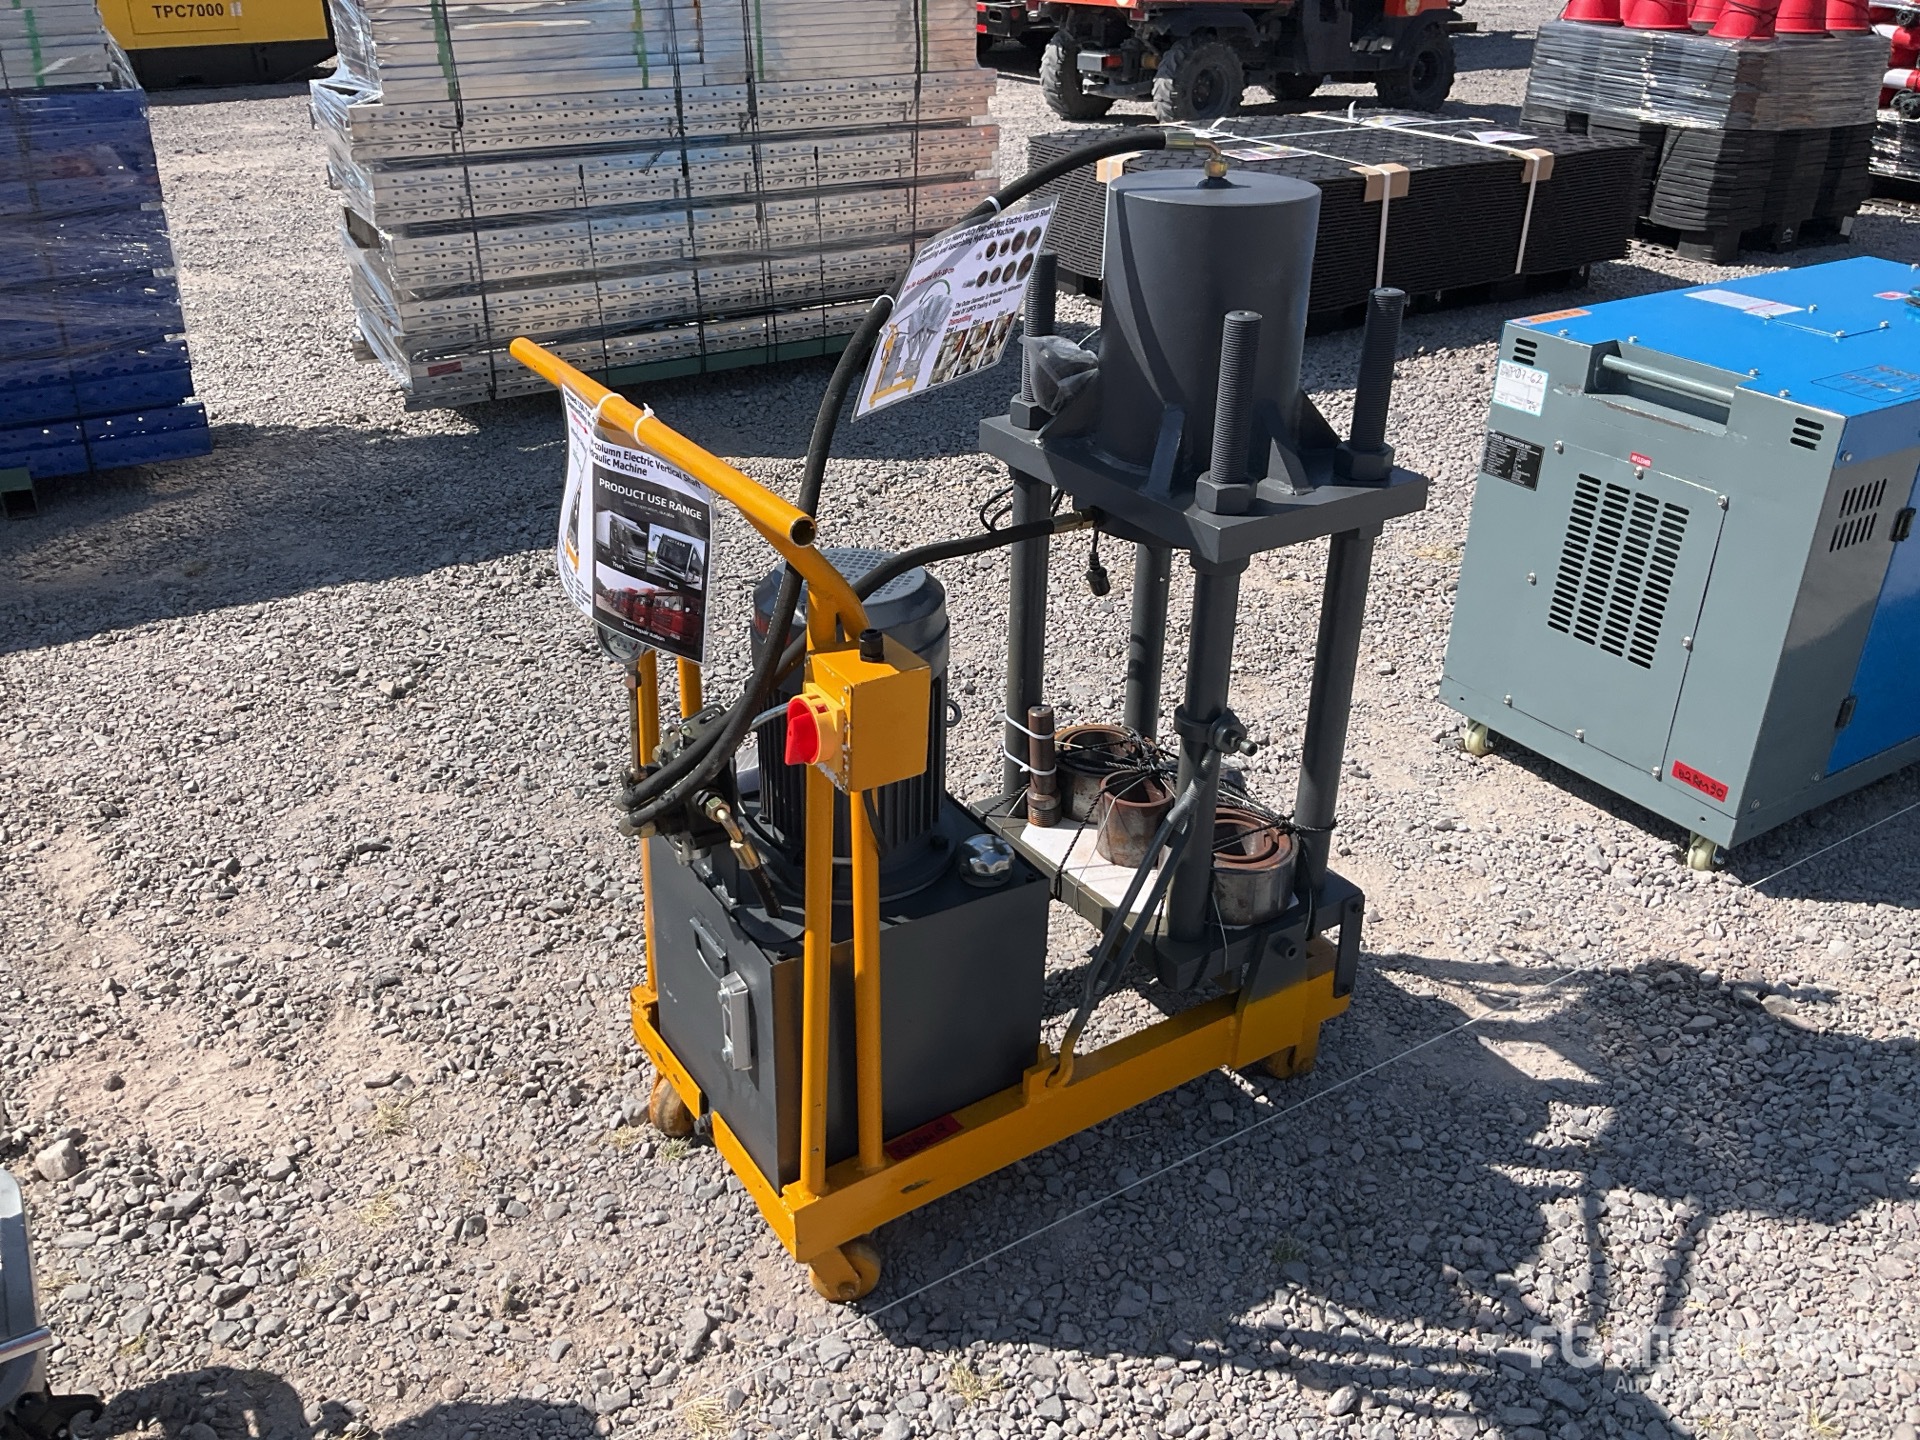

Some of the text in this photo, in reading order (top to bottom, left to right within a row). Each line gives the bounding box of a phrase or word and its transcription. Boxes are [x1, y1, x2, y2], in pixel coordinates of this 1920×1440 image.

[151, 3, 224, 18] TPC7000
[612, 458, 648, 476] Machine
[623, 450, 654, 468] Electric
[655, 460, 682, 480] Vertical
[683, 473, 702, 490] Shaft
[599, 477, 702, 520] PRODUCT USE RANGE
[611, 560, 626, 571] Truck
